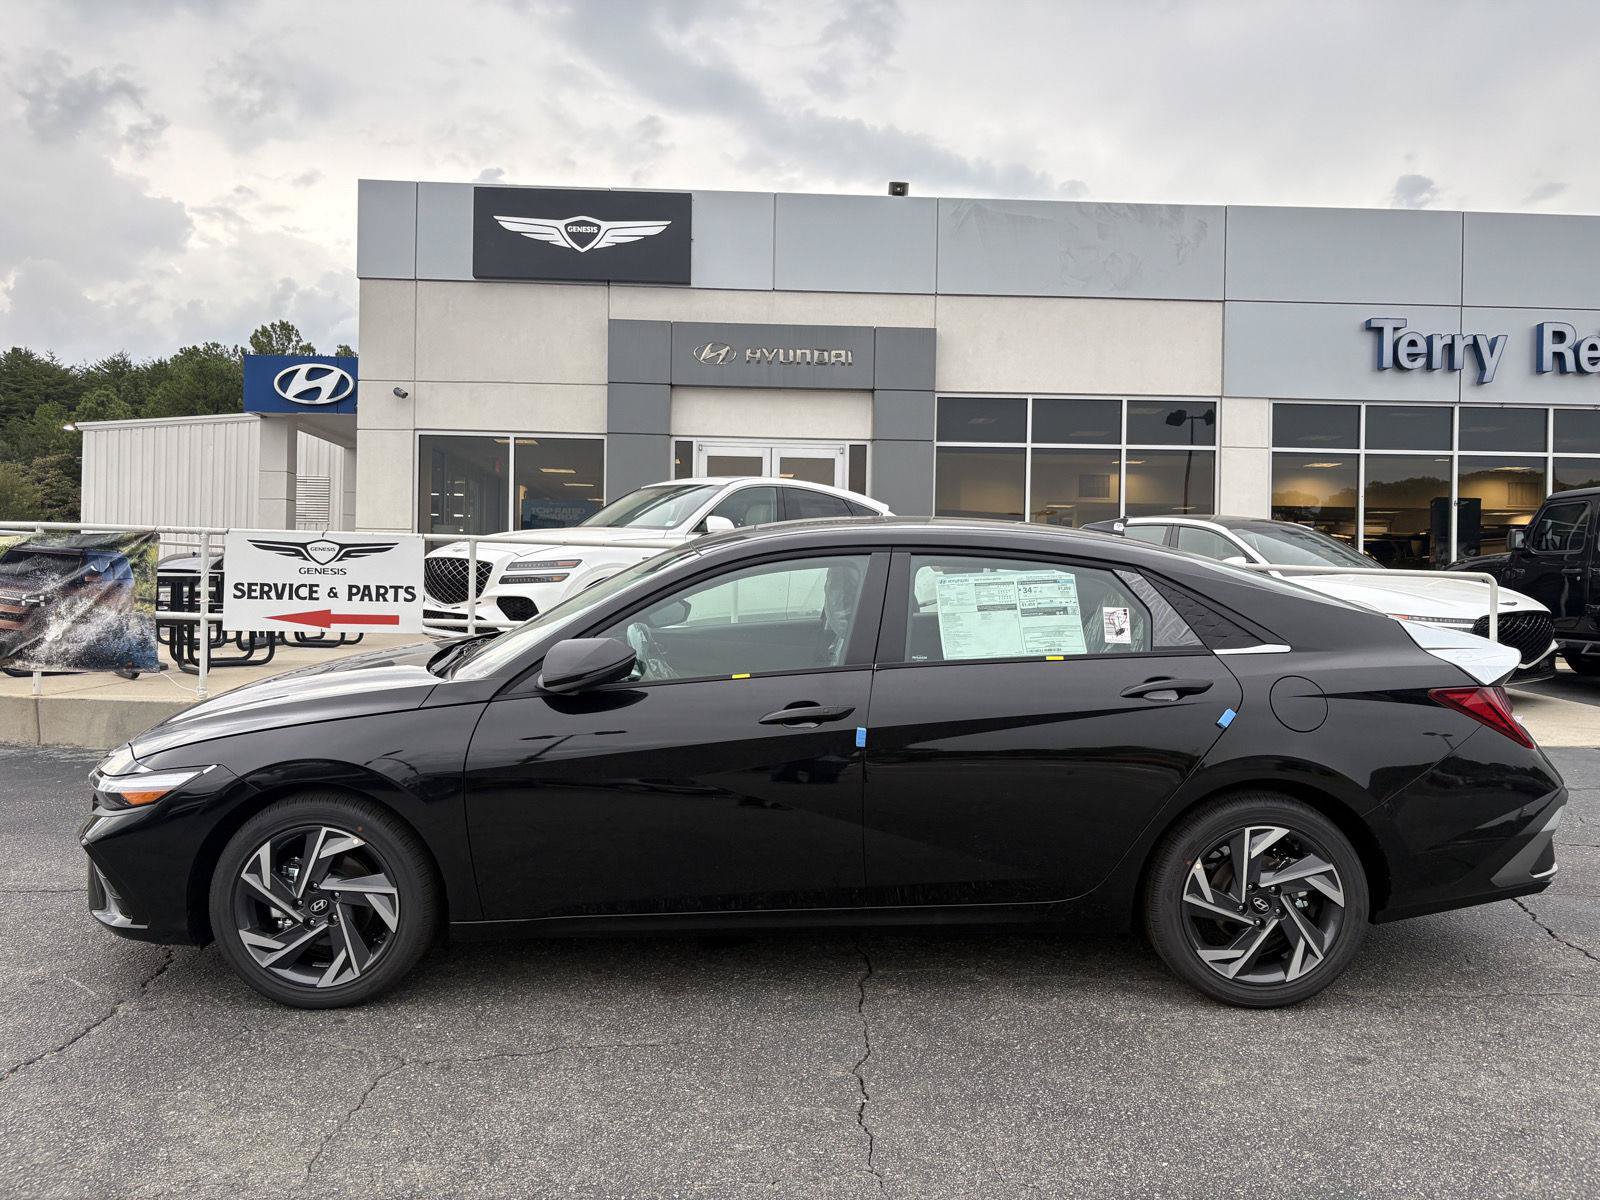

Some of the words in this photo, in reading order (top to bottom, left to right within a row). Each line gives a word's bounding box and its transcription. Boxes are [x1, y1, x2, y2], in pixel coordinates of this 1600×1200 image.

[567, 225, 598, 233] GENESIS
[745, 348, 853, 366] HYUNDAI
[1365, 317, 1508, 384] Terry
[298, 567, 347, 576] GENESIS
[232, 582, 320, 601] SERVICE
[327, 586, 339, 599] &
[347, 585, 417, 602] PARTS
